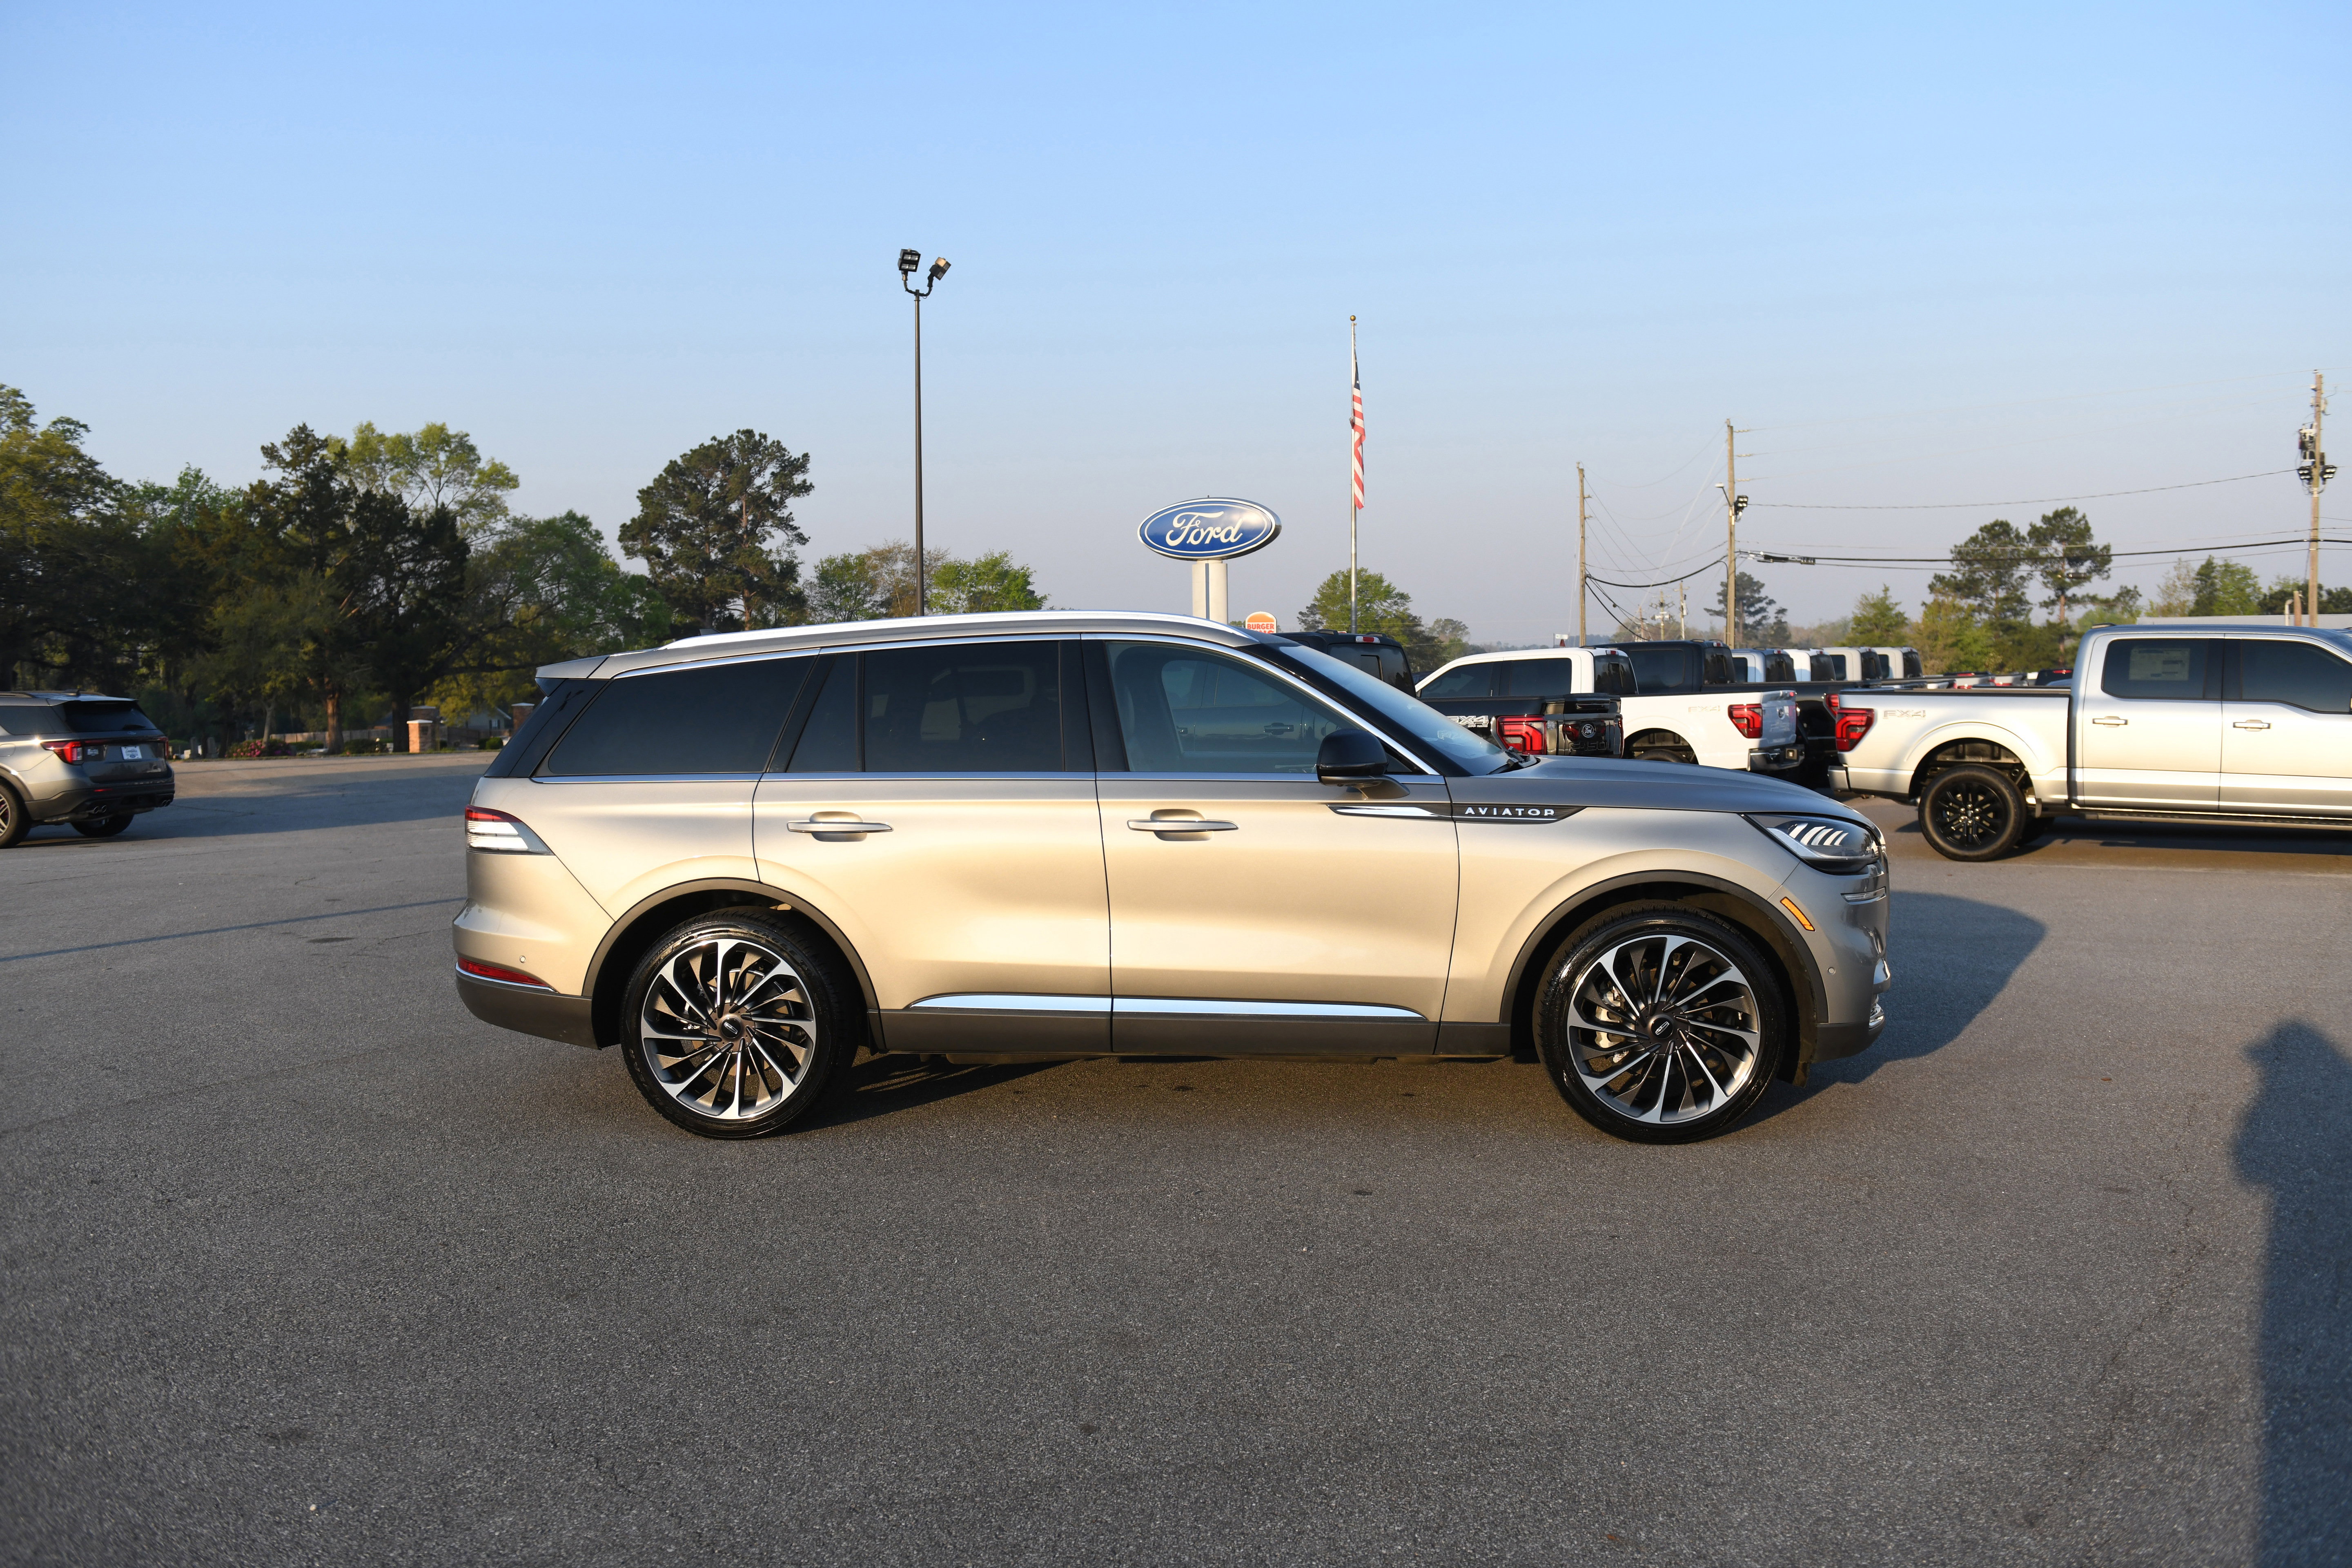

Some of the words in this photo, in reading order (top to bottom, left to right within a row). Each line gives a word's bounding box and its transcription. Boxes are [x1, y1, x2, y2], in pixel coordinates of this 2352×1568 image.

[1166, 511, 1243, 546] Ford
[1883, 710, 1926, 719] FX4
[1584, 726, 1592, 734] Ford
[1465, 807, 1555, 816] AVIATOR
